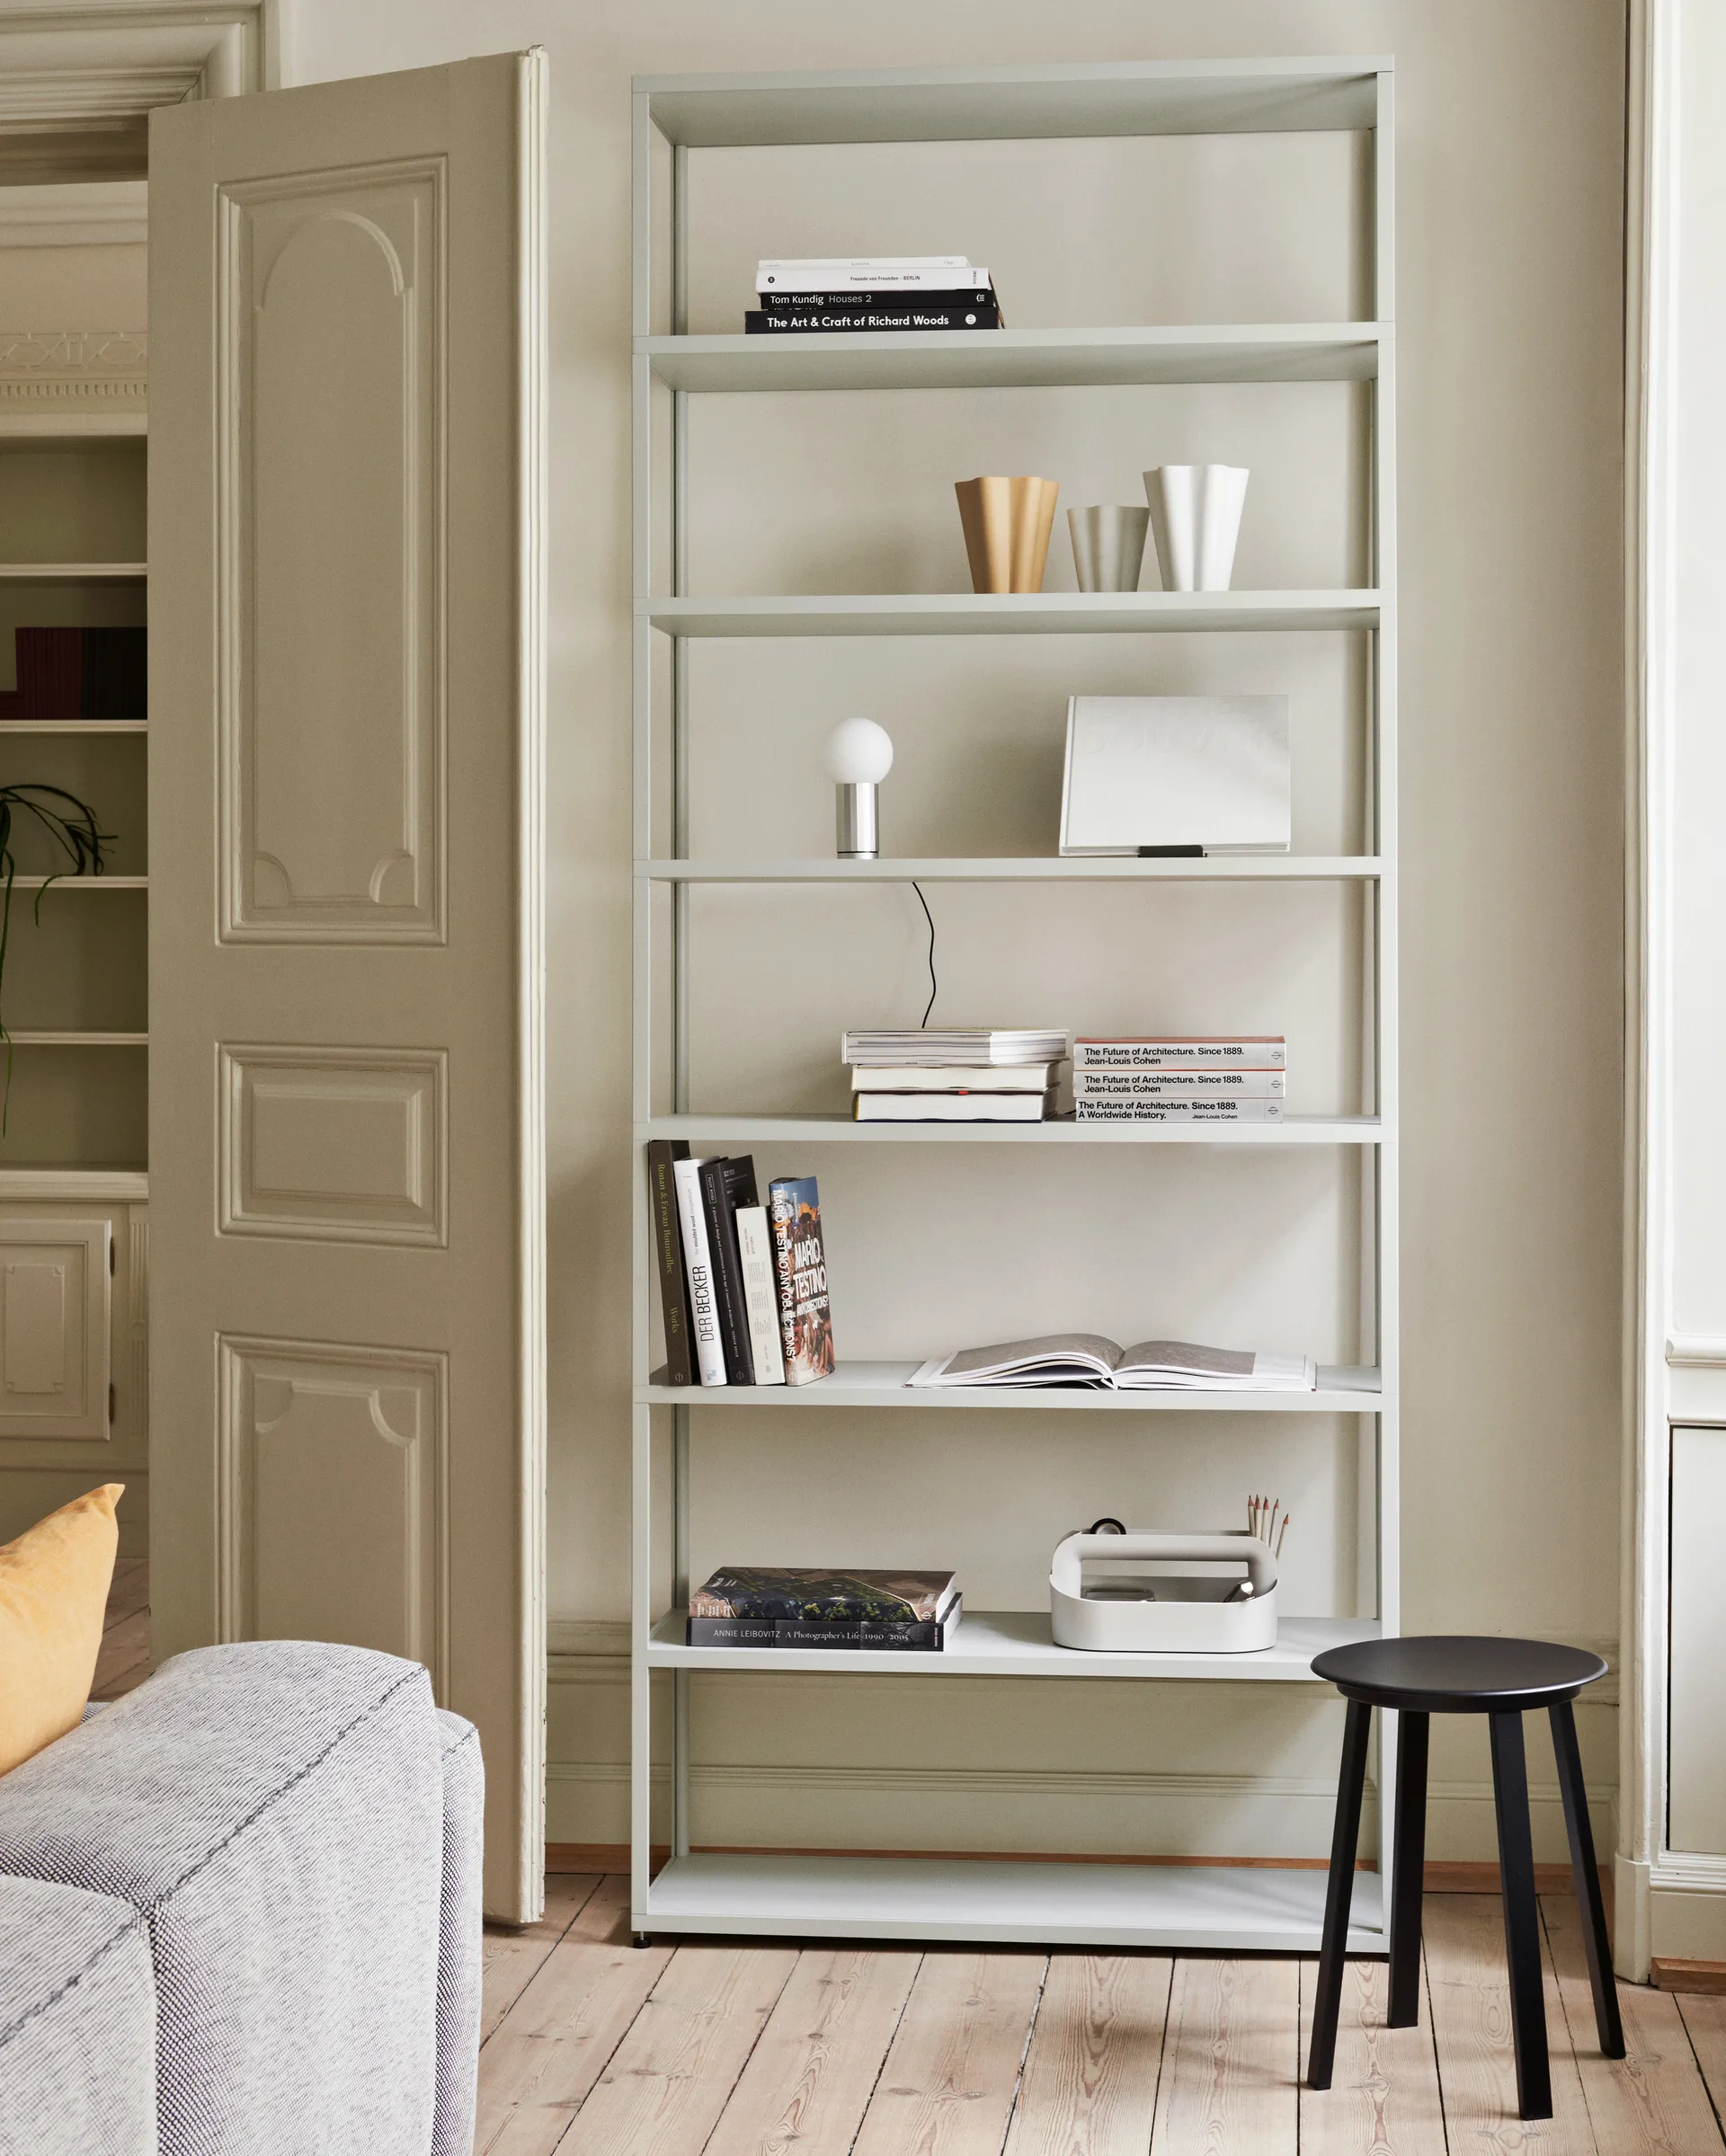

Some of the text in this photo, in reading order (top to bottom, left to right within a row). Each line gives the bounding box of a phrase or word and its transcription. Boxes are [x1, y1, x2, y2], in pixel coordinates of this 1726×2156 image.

[792, 295, 824, 305] Kundig
[767, 315, 949, 327] The Art & Craft of Richard Woods
[1134, 1111, 1166, 1120] History.
[664, 1230, 675, 1274] Bouroullec
[794, 1237, 820, 1271] MARIO
[773, 1190, 796, 1361] MARIO TESTINO ANY OBJECTIONS?
[793, 1265, 827, 1300] TESTINO
[692, 1266, 714, 1341] DER BECKER
[670, 1307, 679, 1333] Works
[794, 1631, 845, 1641] Photographer's
